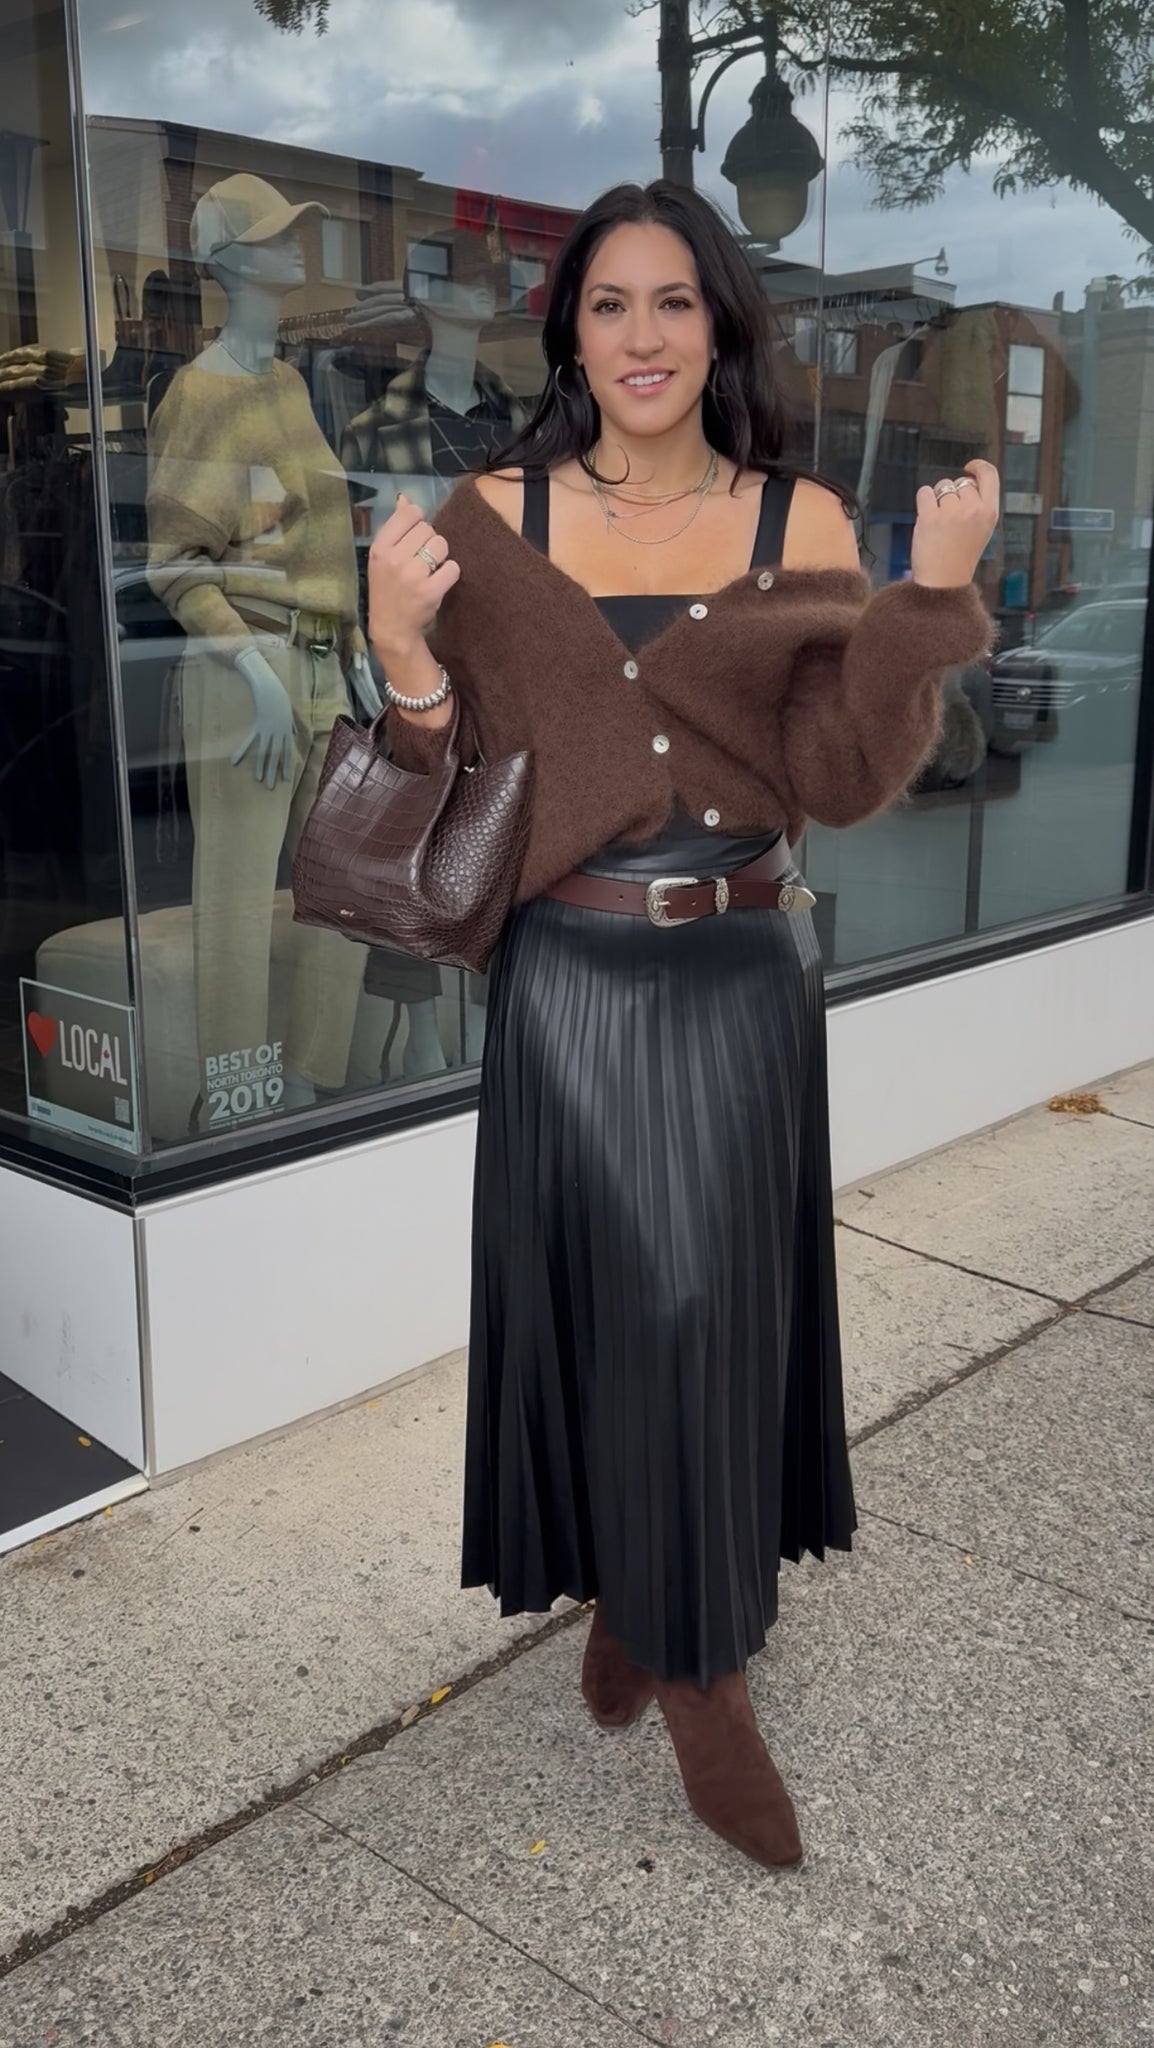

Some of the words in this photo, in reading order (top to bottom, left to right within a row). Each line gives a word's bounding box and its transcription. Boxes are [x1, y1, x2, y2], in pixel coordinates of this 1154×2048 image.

[59, 1020, 128, 1085] LOCAL
[206, 1048, 252, 1076] BEST
[256, 1041, 282, 1063] OF
[207, 1073, 238, 1089] NORTH
[240, 1063, 283, 1081] TORONTO
[209, 1077, 284, 1120] 2019
